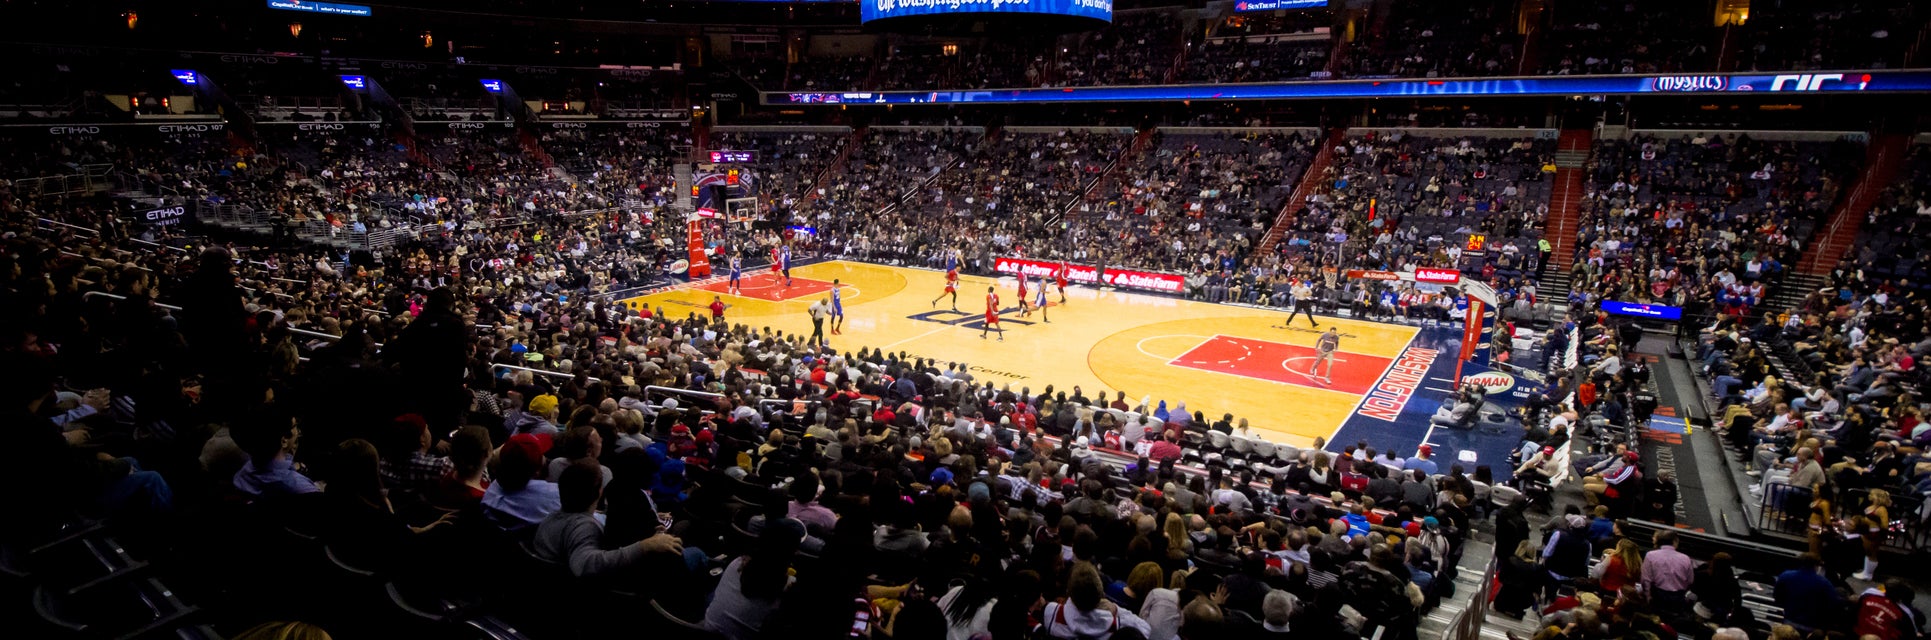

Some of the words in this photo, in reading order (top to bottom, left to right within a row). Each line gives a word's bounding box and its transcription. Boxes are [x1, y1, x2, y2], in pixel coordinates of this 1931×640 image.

[220, 55, 279, 64] ETIHAD
[49, 126, 101, 135] ETIHAD
[159, 124, 209, 133] ETIHAD
[298, 123, 345, 131] ETIHAD
[146, 206, 185, 220] ETIHAD
[1357, 346, 1440, 423] WASHINGTON
